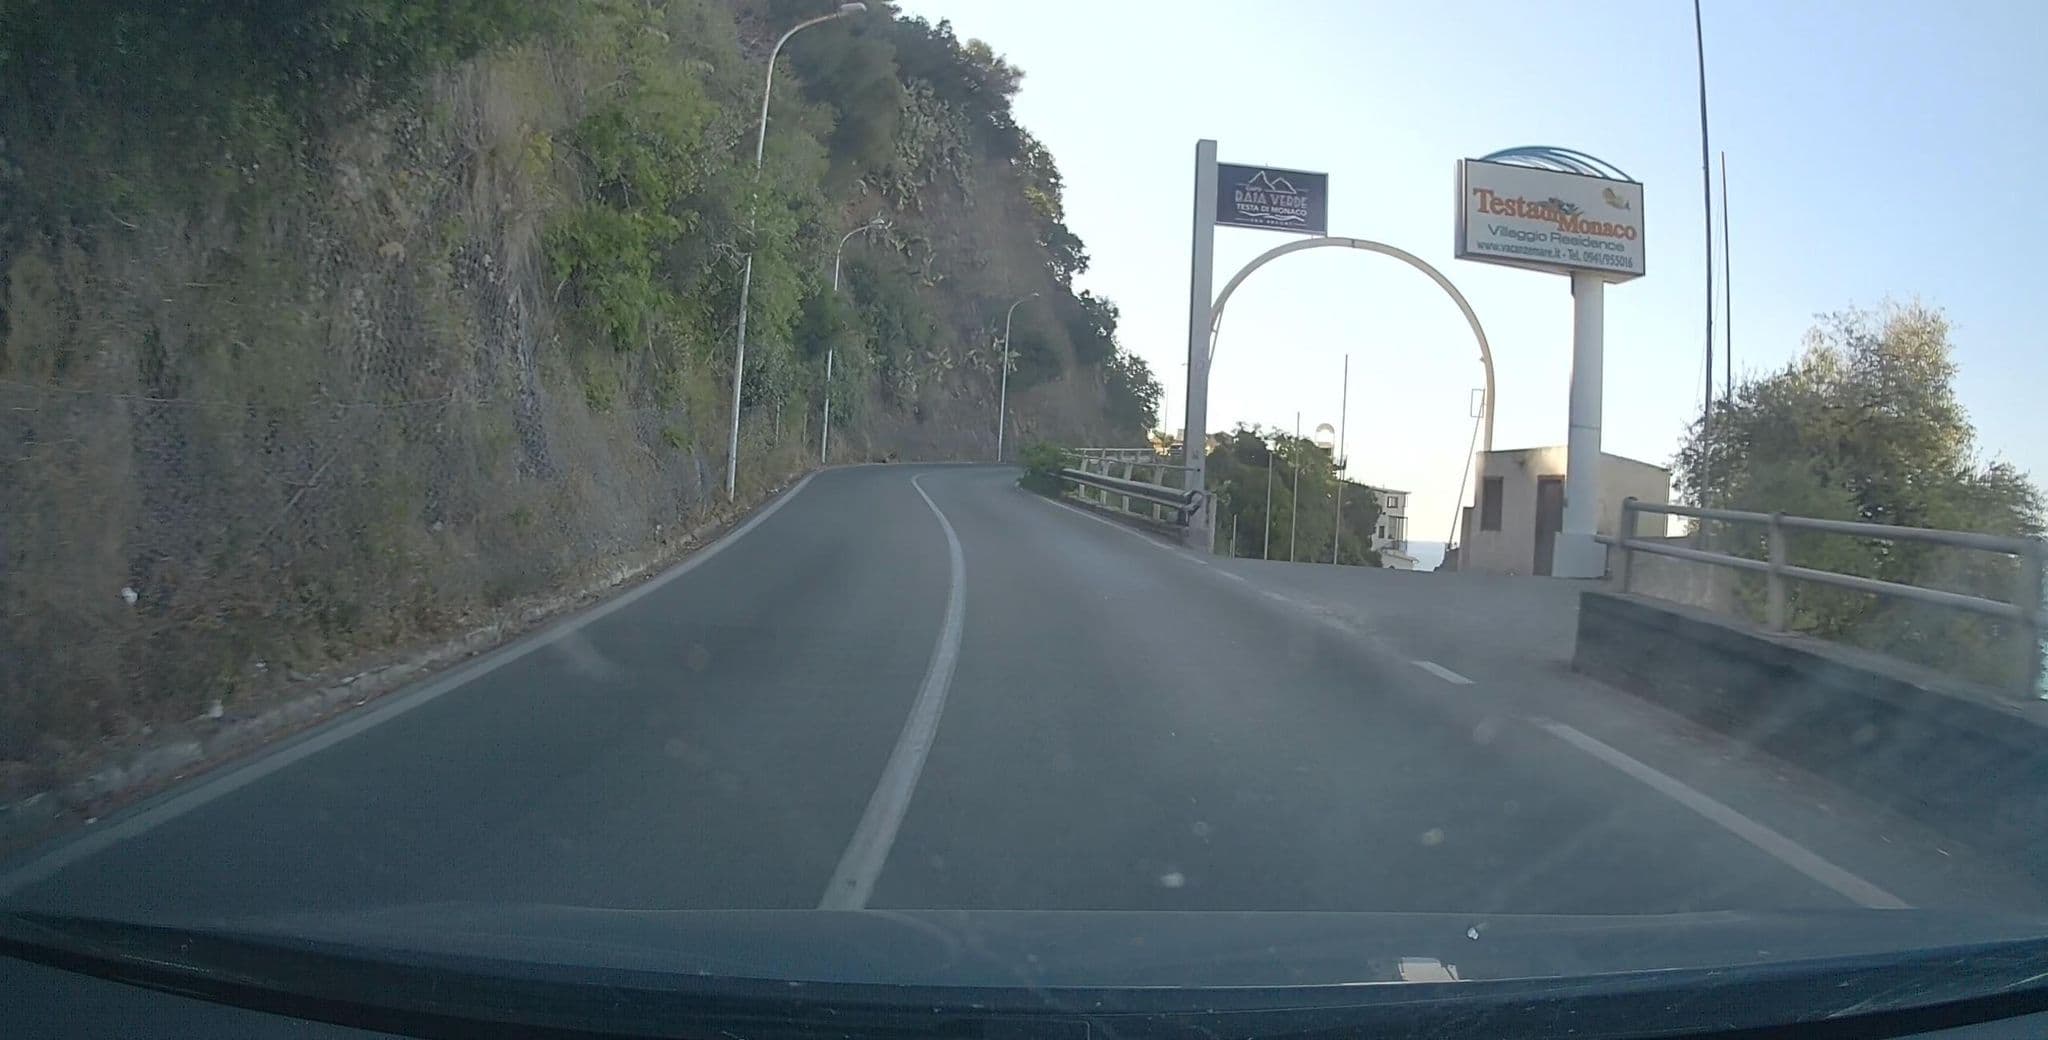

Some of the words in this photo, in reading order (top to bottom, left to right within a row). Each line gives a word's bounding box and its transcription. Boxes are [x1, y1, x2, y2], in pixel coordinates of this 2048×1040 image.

[1236, 203, 1259, 213] TESTA
[1261, 205, 1270, 213] DI
[1271, 206, 1308, 217] MONACO
[1472, 187, 1541, 219] Testa
[1557, 213, 1637, 241] Monaco
[1487, 223, 1548, 243] Villaggio
[1550, 231, 1625, 252] Residence
